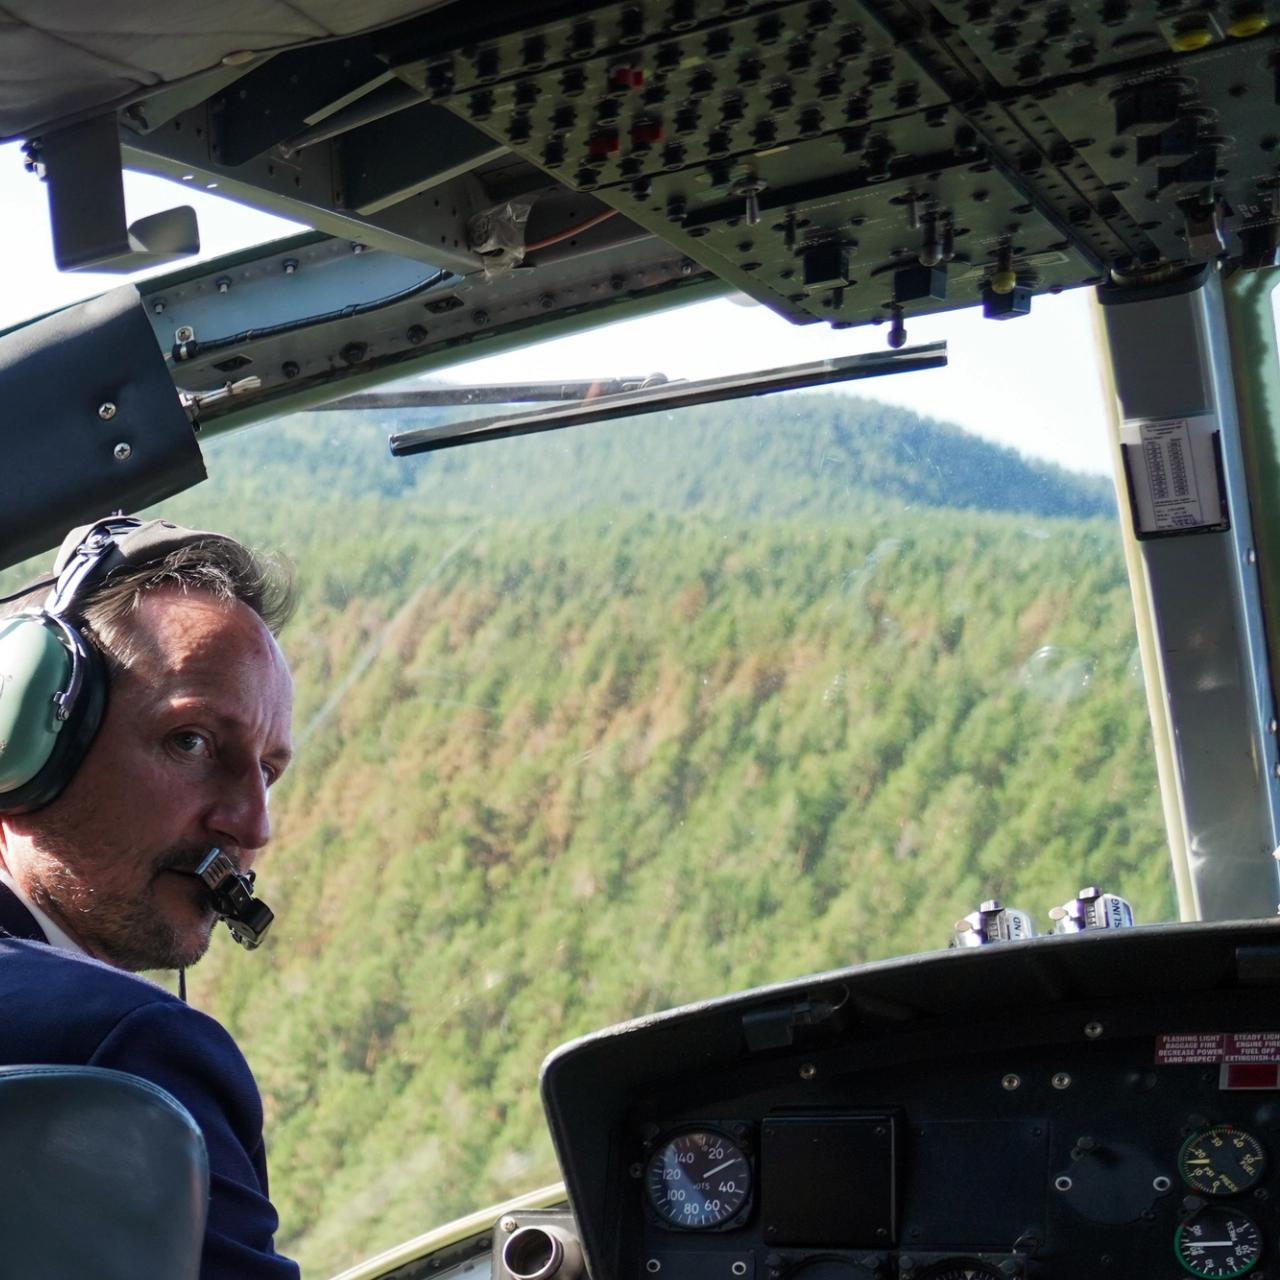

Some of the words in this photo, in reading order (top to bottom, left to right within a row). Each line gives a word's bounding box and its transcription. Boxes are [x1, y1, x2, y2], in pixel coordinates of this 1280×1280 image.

[1162, 1034, 1198, 1042] FLASHING
[1200, 1034, 1220, 1042] LIGHT
[1233, 1033, 1260, 1041] STEADY
[1200, 1041, 1217, 1049] FIRE
[675, 1152, 695, 1164] 140
[708, 1148, 724, 1160] 20
[662, 1169, 681, 1180] 120
[666, 1189, 686, 1201] 100
[718, 1181, 735, 1193] 40
[683, 1203, 700, 1215] 80
[704, 1199, 721, 1211] 60
